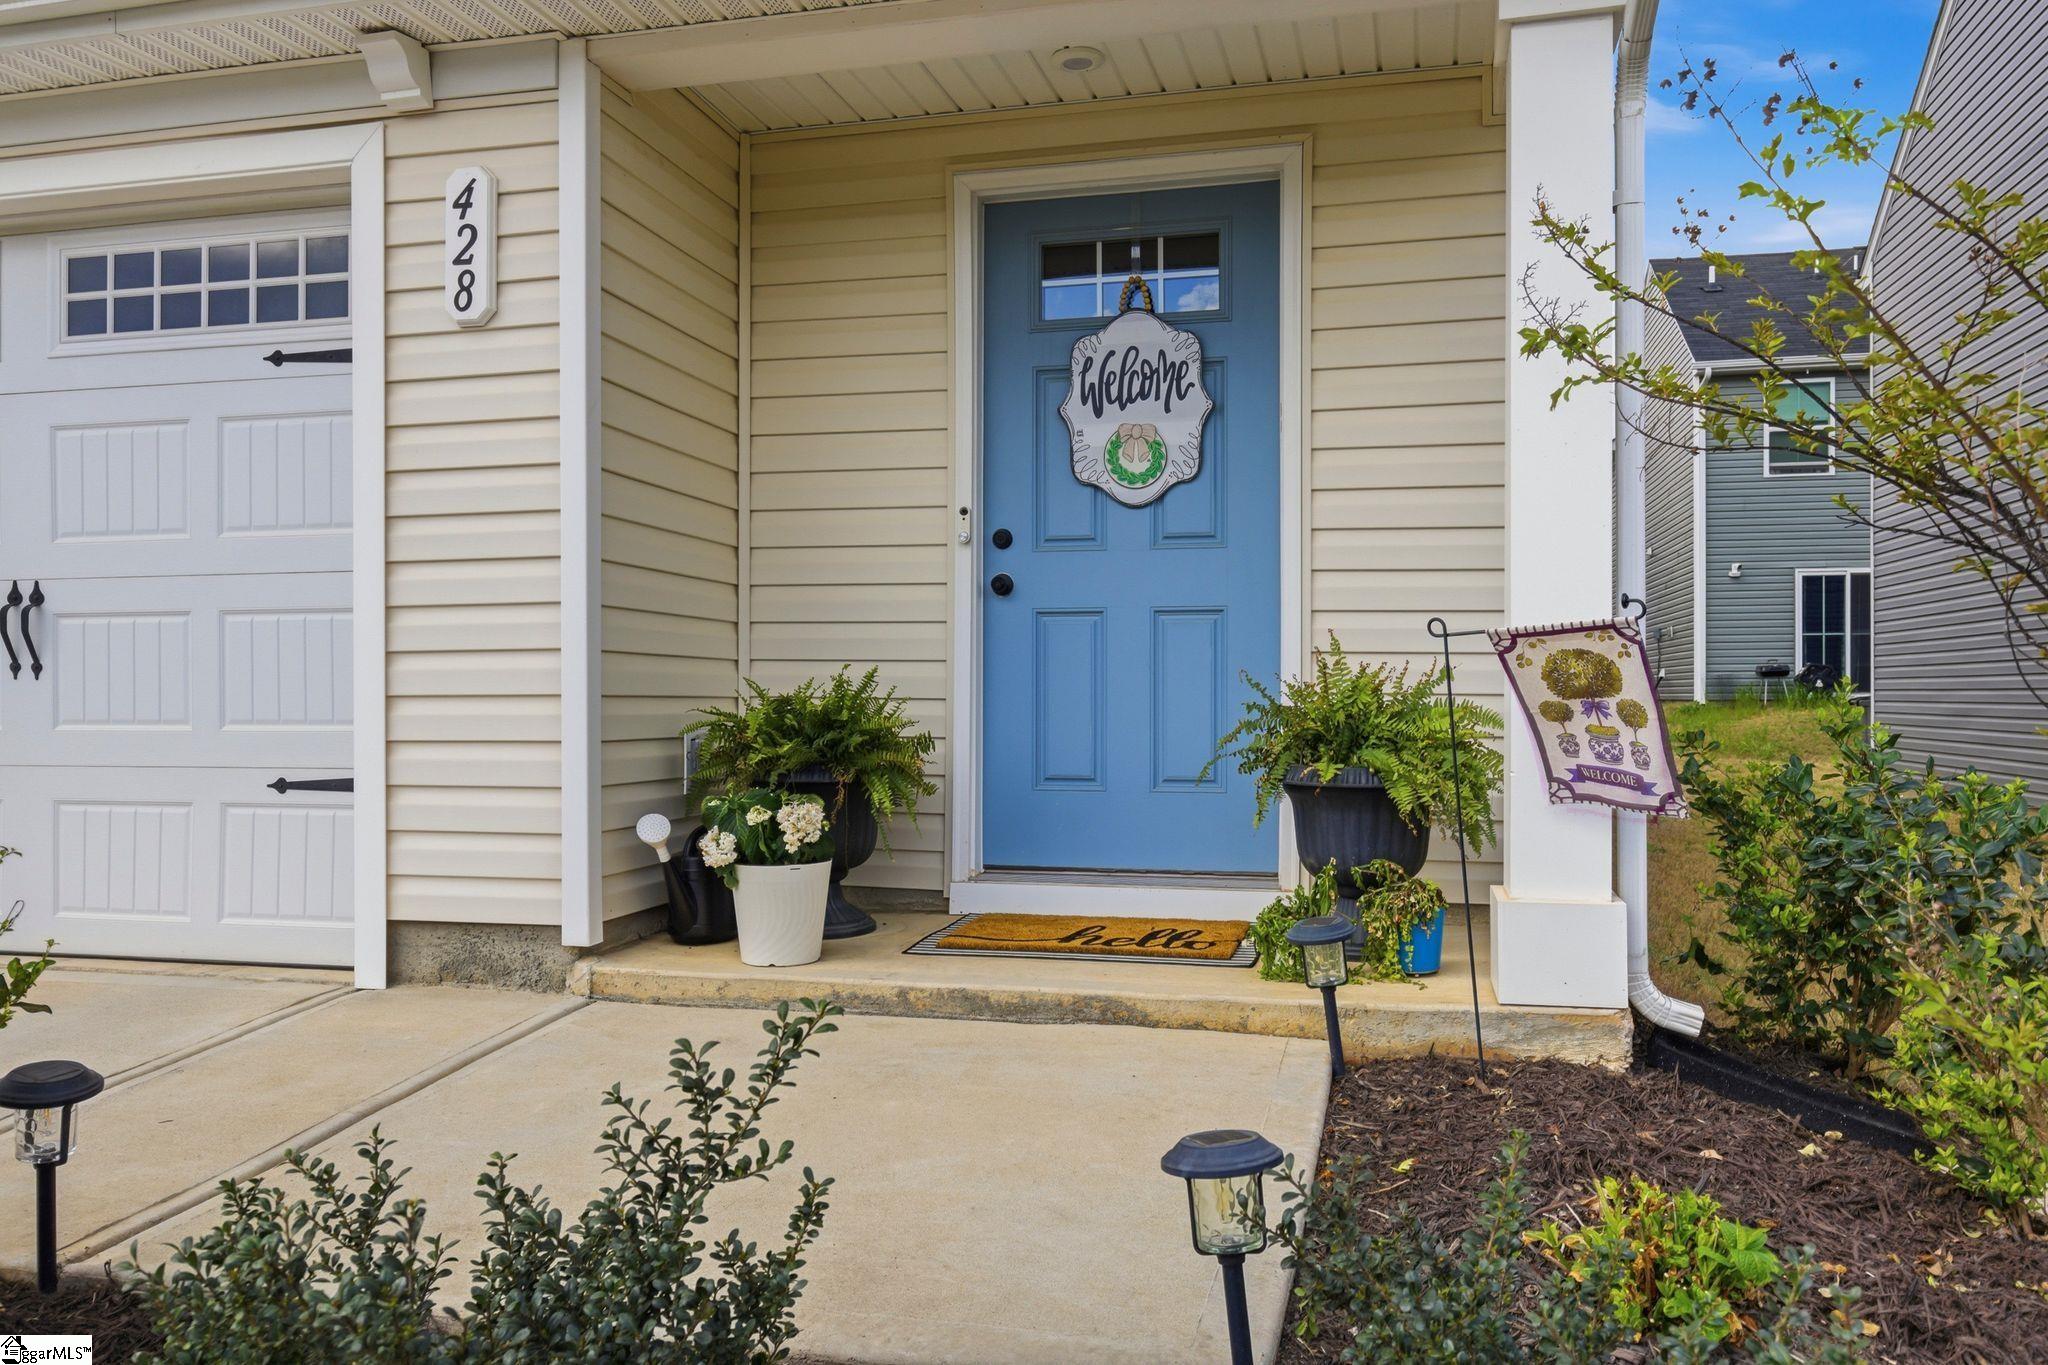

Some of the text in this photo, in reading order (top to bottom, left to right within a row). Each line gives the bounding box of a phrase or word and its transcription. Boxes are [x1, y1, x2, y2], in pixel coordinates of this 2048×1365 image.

[452, 178, 478, 312] 428
[1078, 345, 1196, 420] Welcome
[1580, 766, 1638, 787] WELCOME
[1056, 925, 1218, 950] hello
